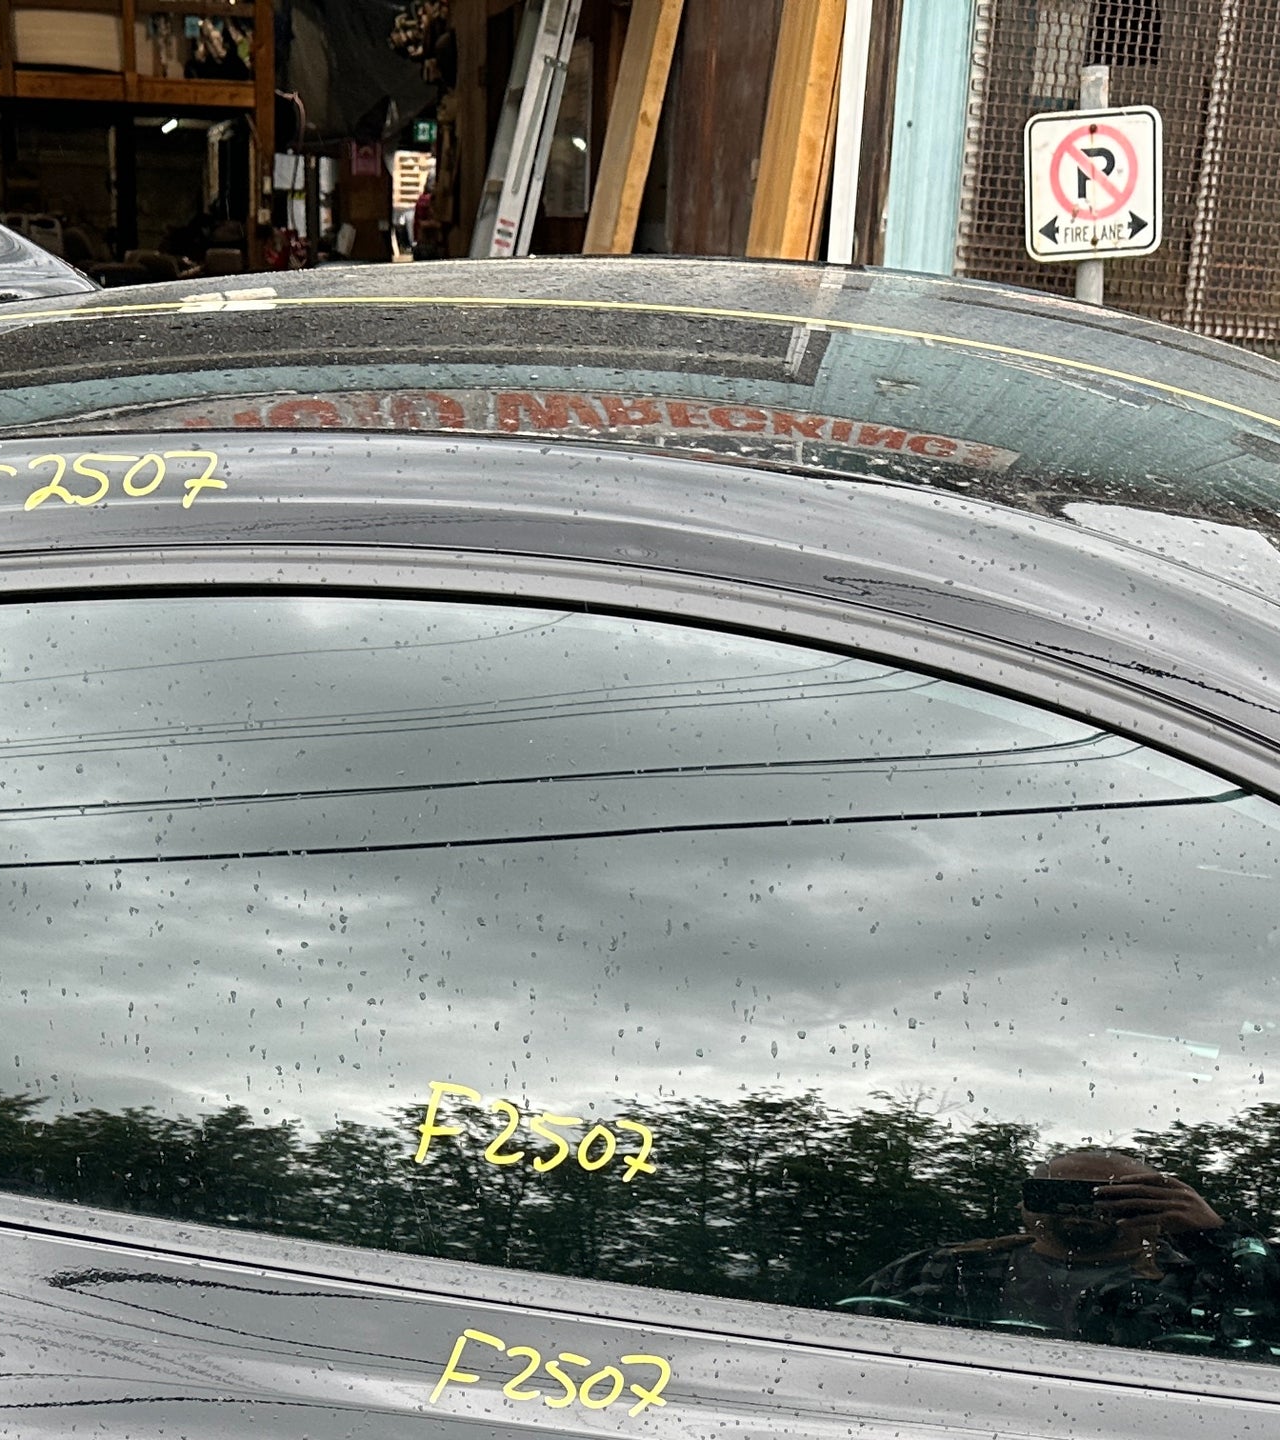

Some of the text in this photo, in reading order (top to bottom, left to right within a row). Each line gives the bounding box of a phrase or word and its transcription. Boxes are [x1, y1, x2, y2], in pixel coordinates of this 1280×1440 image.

[1077, 147, 1116, 199] P
[1063, 223, 1128, 243] FIRE LANE
[414, 1080, 657, 1183] F2507
[428, 1328, 673, 1417] F2507
